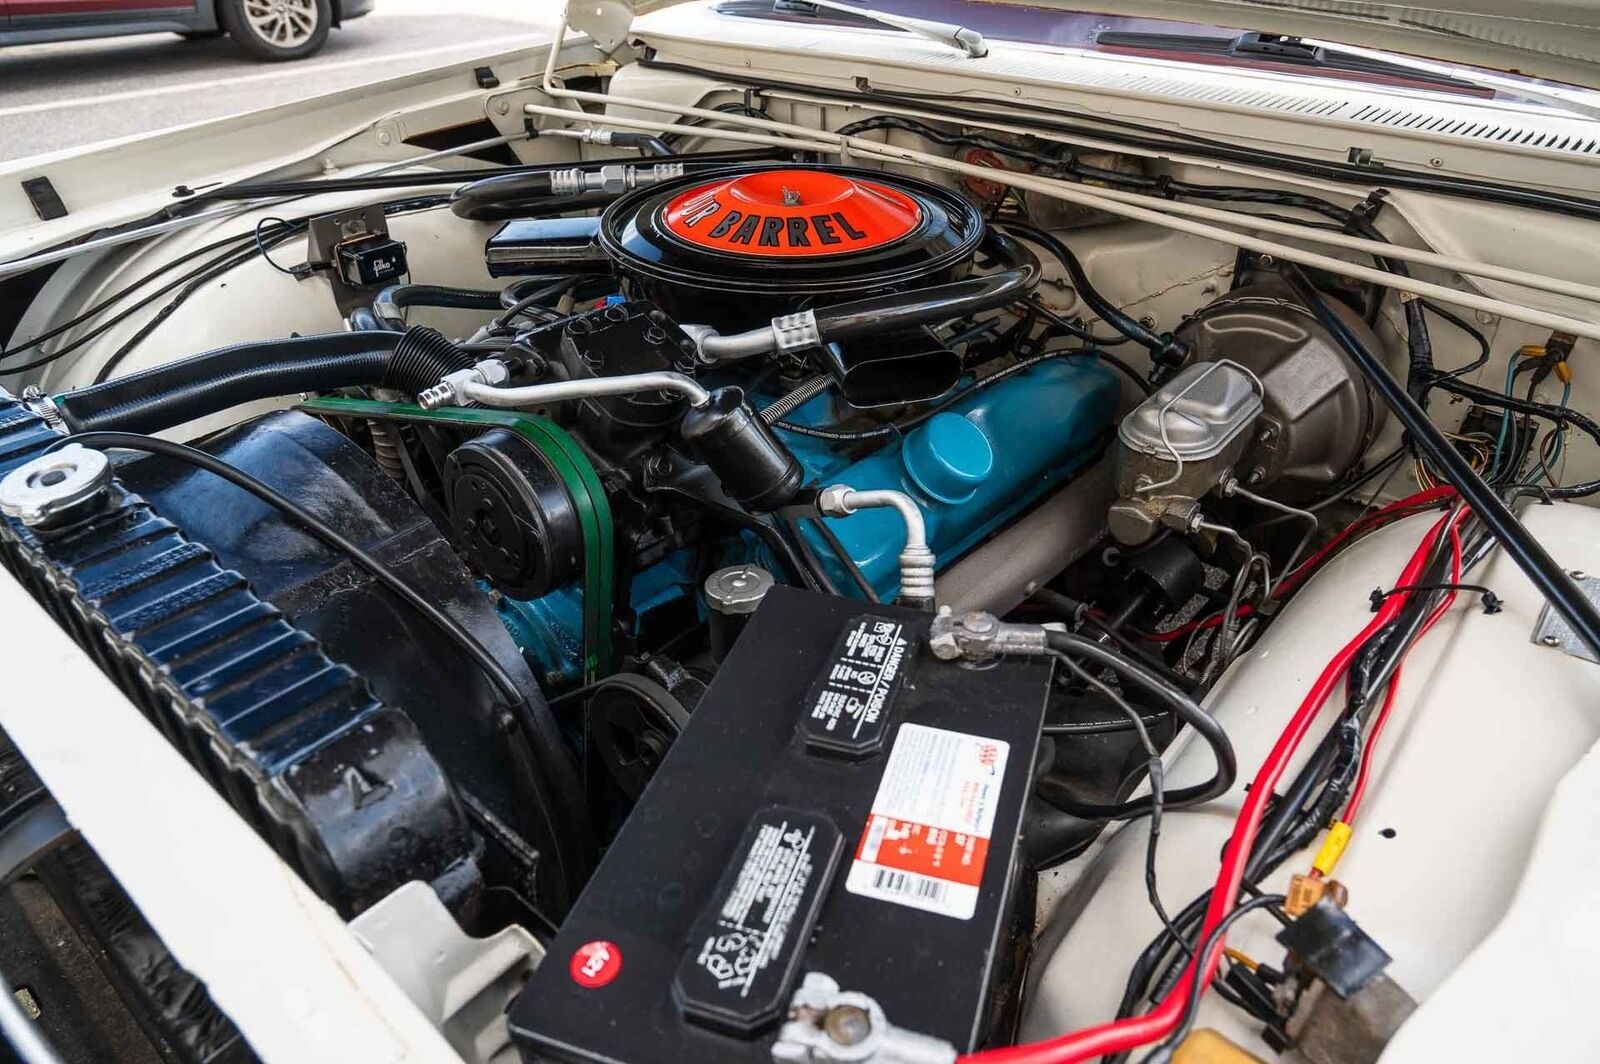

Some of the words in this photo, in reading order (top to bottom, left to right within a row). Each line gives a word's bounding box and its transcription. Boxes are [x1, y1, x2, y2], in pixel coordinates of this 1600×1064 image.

[707, 210, 868, 247] BARREL
[882, 646, 905, 681] DANGER
[864, 687, 889, 723] POISON
